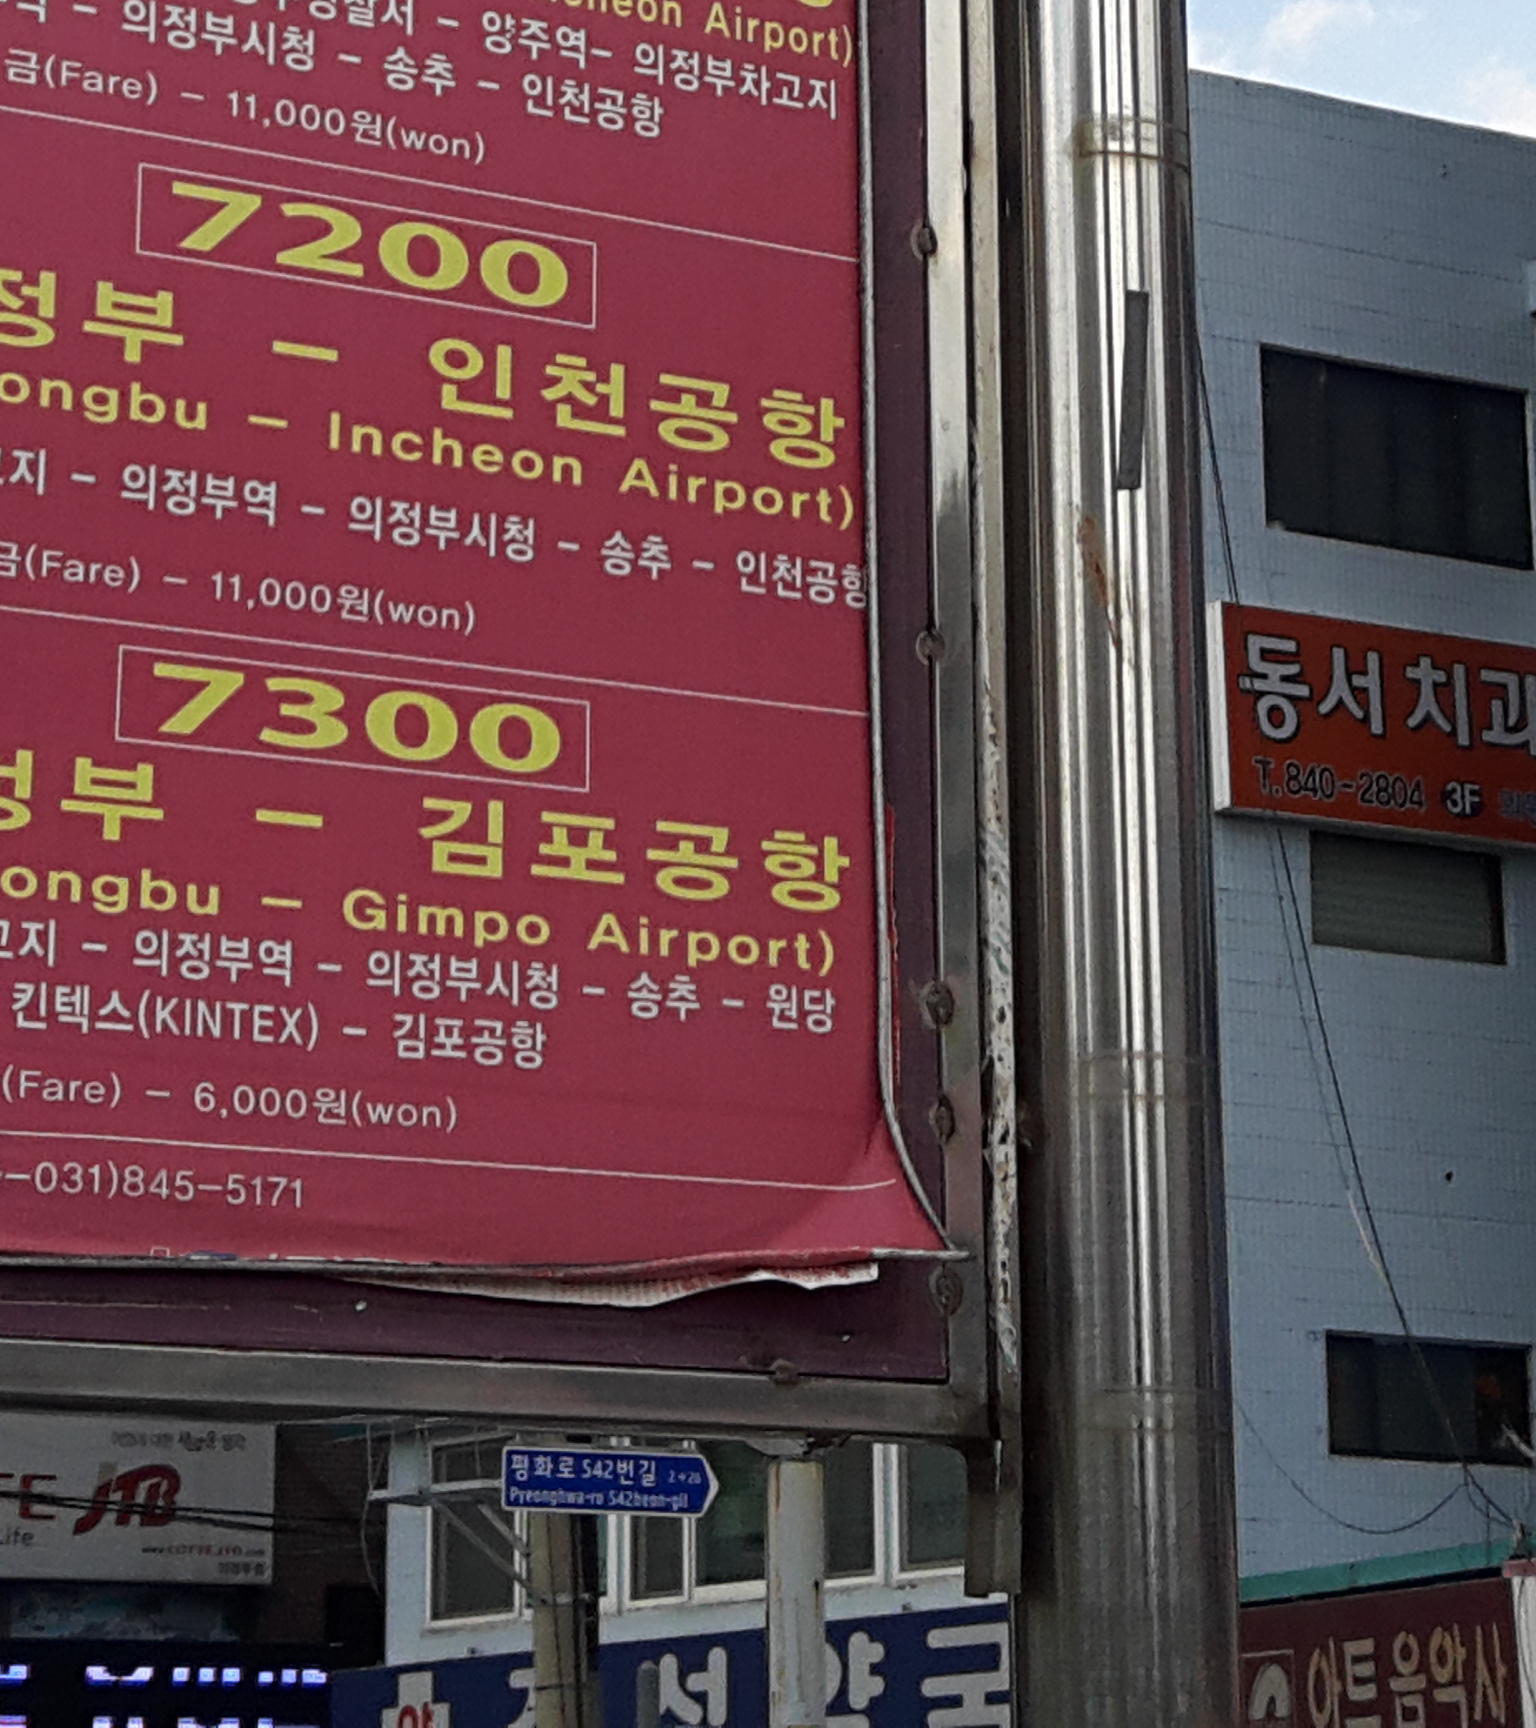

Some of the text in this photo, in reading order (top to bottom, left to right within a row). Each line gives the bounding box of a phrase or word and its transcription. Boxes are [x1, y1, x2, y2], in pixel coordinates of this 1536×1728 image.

[633, 41, 839, 121] 의정부차고지
[703, 1, 853, 69] Airport)
[383, 44, 457, 97] 송추
[521, 73, 666, 140] 인천공항
[171, 180, 570, 309] 7200
[427, 336, 846, 471] 인천공항
[328, 410, 584, 489] Incheon
[617, 457, 856, 532] Airport)
[120, 463, 280, 528] 의정부역
[347, 495, 537, 564] 의정부시청
[599, 530, 673, 582] 송추
[734, 549, 868, 610] 인천공항
[153, 661, 562, 773] 7300
[1444, 779, 1482, 814] 3F
[417, 796, 851, 914] 김포공항
[132, 928, 293, 987] 의정부역
[365, 949, 561, 1012] 의정부시청
[626, 971, 701, 1022] 송추
[765, 983, 836, 1035] 원당
[341, 888, 552, 949] Gimpo
[586, 912, 836, 977] Airport)
[11, 981, 320, 1051] 킨텍스(KINTEX)
[392, 1012, 548, 1070] 김포공항
[511, 1453, 576, 1482] 평화로
[581, 1457, 657, 1488] 542번길
